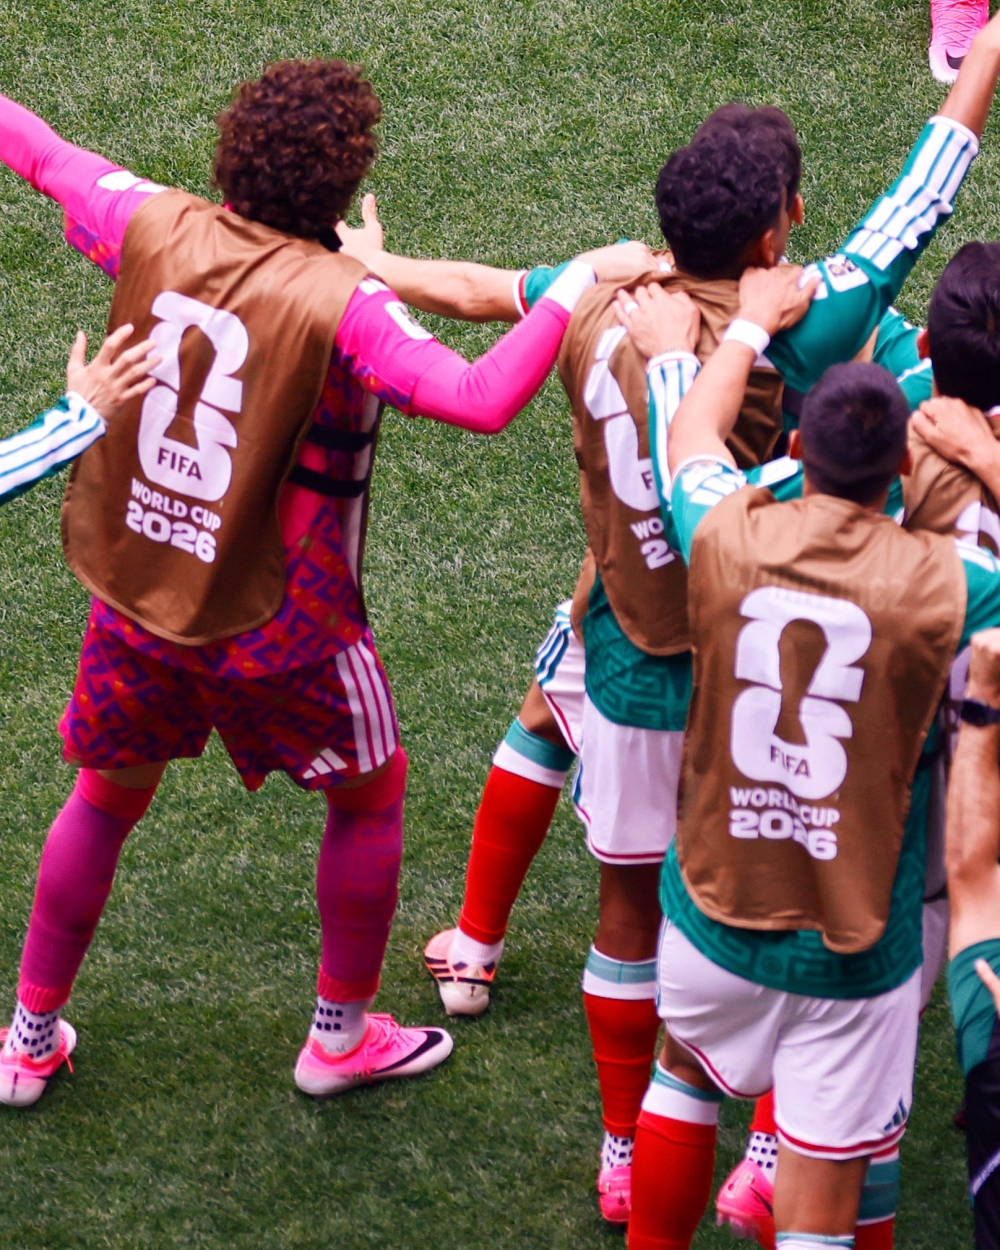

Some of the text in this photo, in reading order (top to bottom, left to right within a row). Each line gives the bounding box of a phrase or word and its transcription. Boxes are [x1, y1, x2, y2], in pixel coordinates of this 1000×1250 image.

[158, 447, 203, 481] FIFA
[131, 477, 222, 532] WORLD CUP
[125, 500, 217, 563] 2026
[770, 745, 811, 778] FIFA
[730, 809, 838, 861] 2026
[799, 805, 841, 828] CUP
